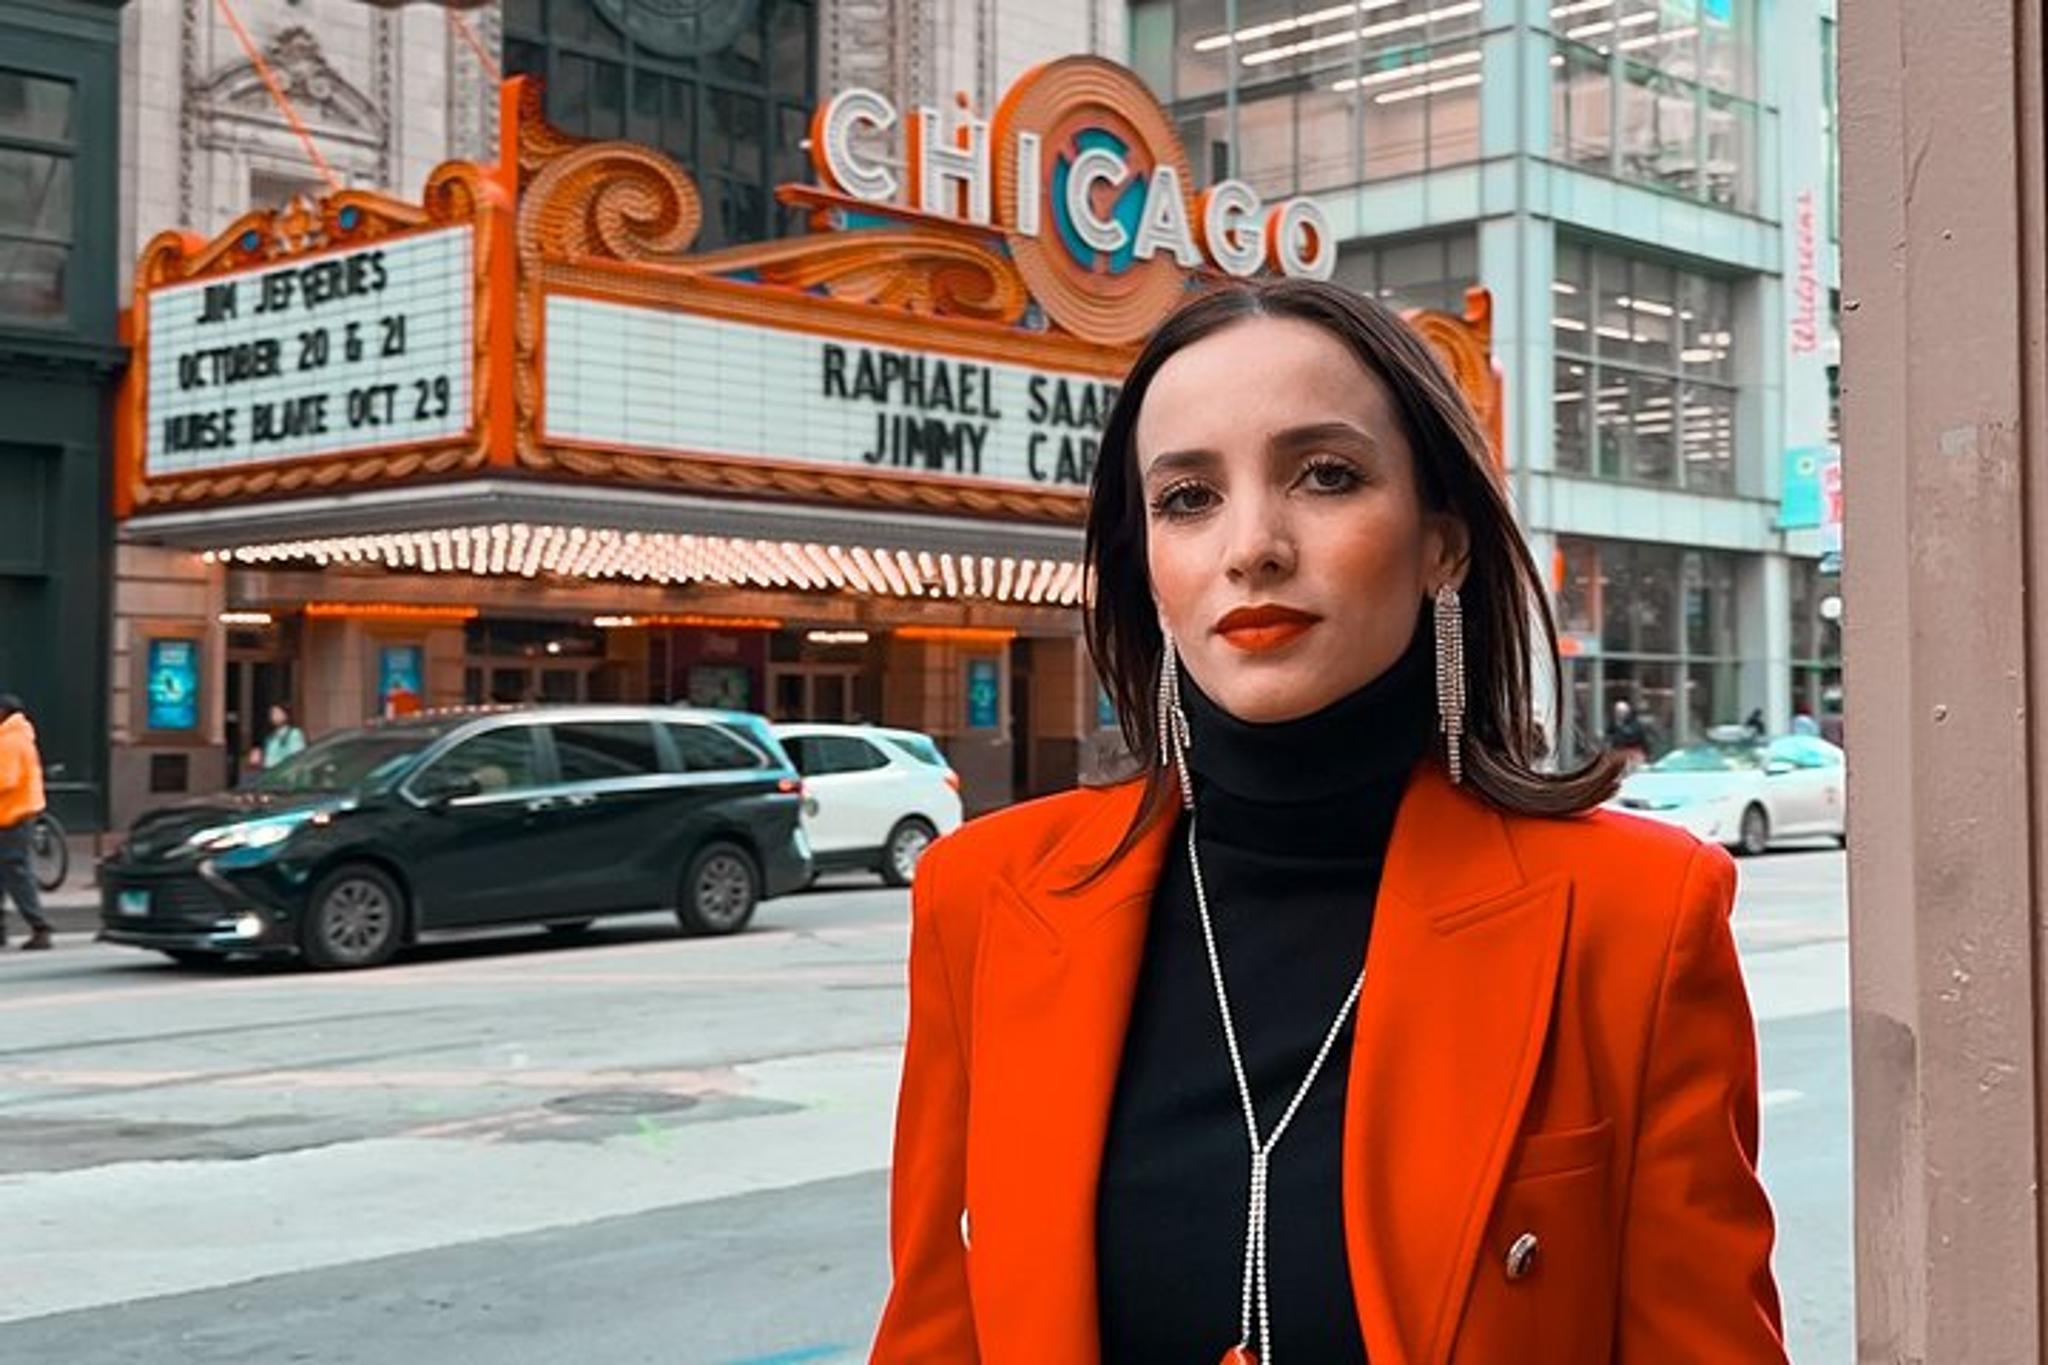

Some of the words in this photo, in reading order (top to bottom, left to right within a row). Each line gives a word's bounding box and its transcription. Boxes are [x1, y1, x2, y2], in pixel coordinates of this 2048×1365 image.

[820, 88, 1337, 282] CHICAGO
[197, 282, 238, 324] JIM
[1791, 192, 1817, 353] Walgreens
[177, 337, 282, 391] OCTOBER
[298, 329, 328, 371] 20
[380, 314, 406, 357] 21
[821, 343, 1000, 420] RAPHAEL
[163, 408, 236, 455] NURSE
[347, 384, 398, 429] OCT
[413, 375, 450, 420] 29
[863, 412, 988, 475] JIMMY
